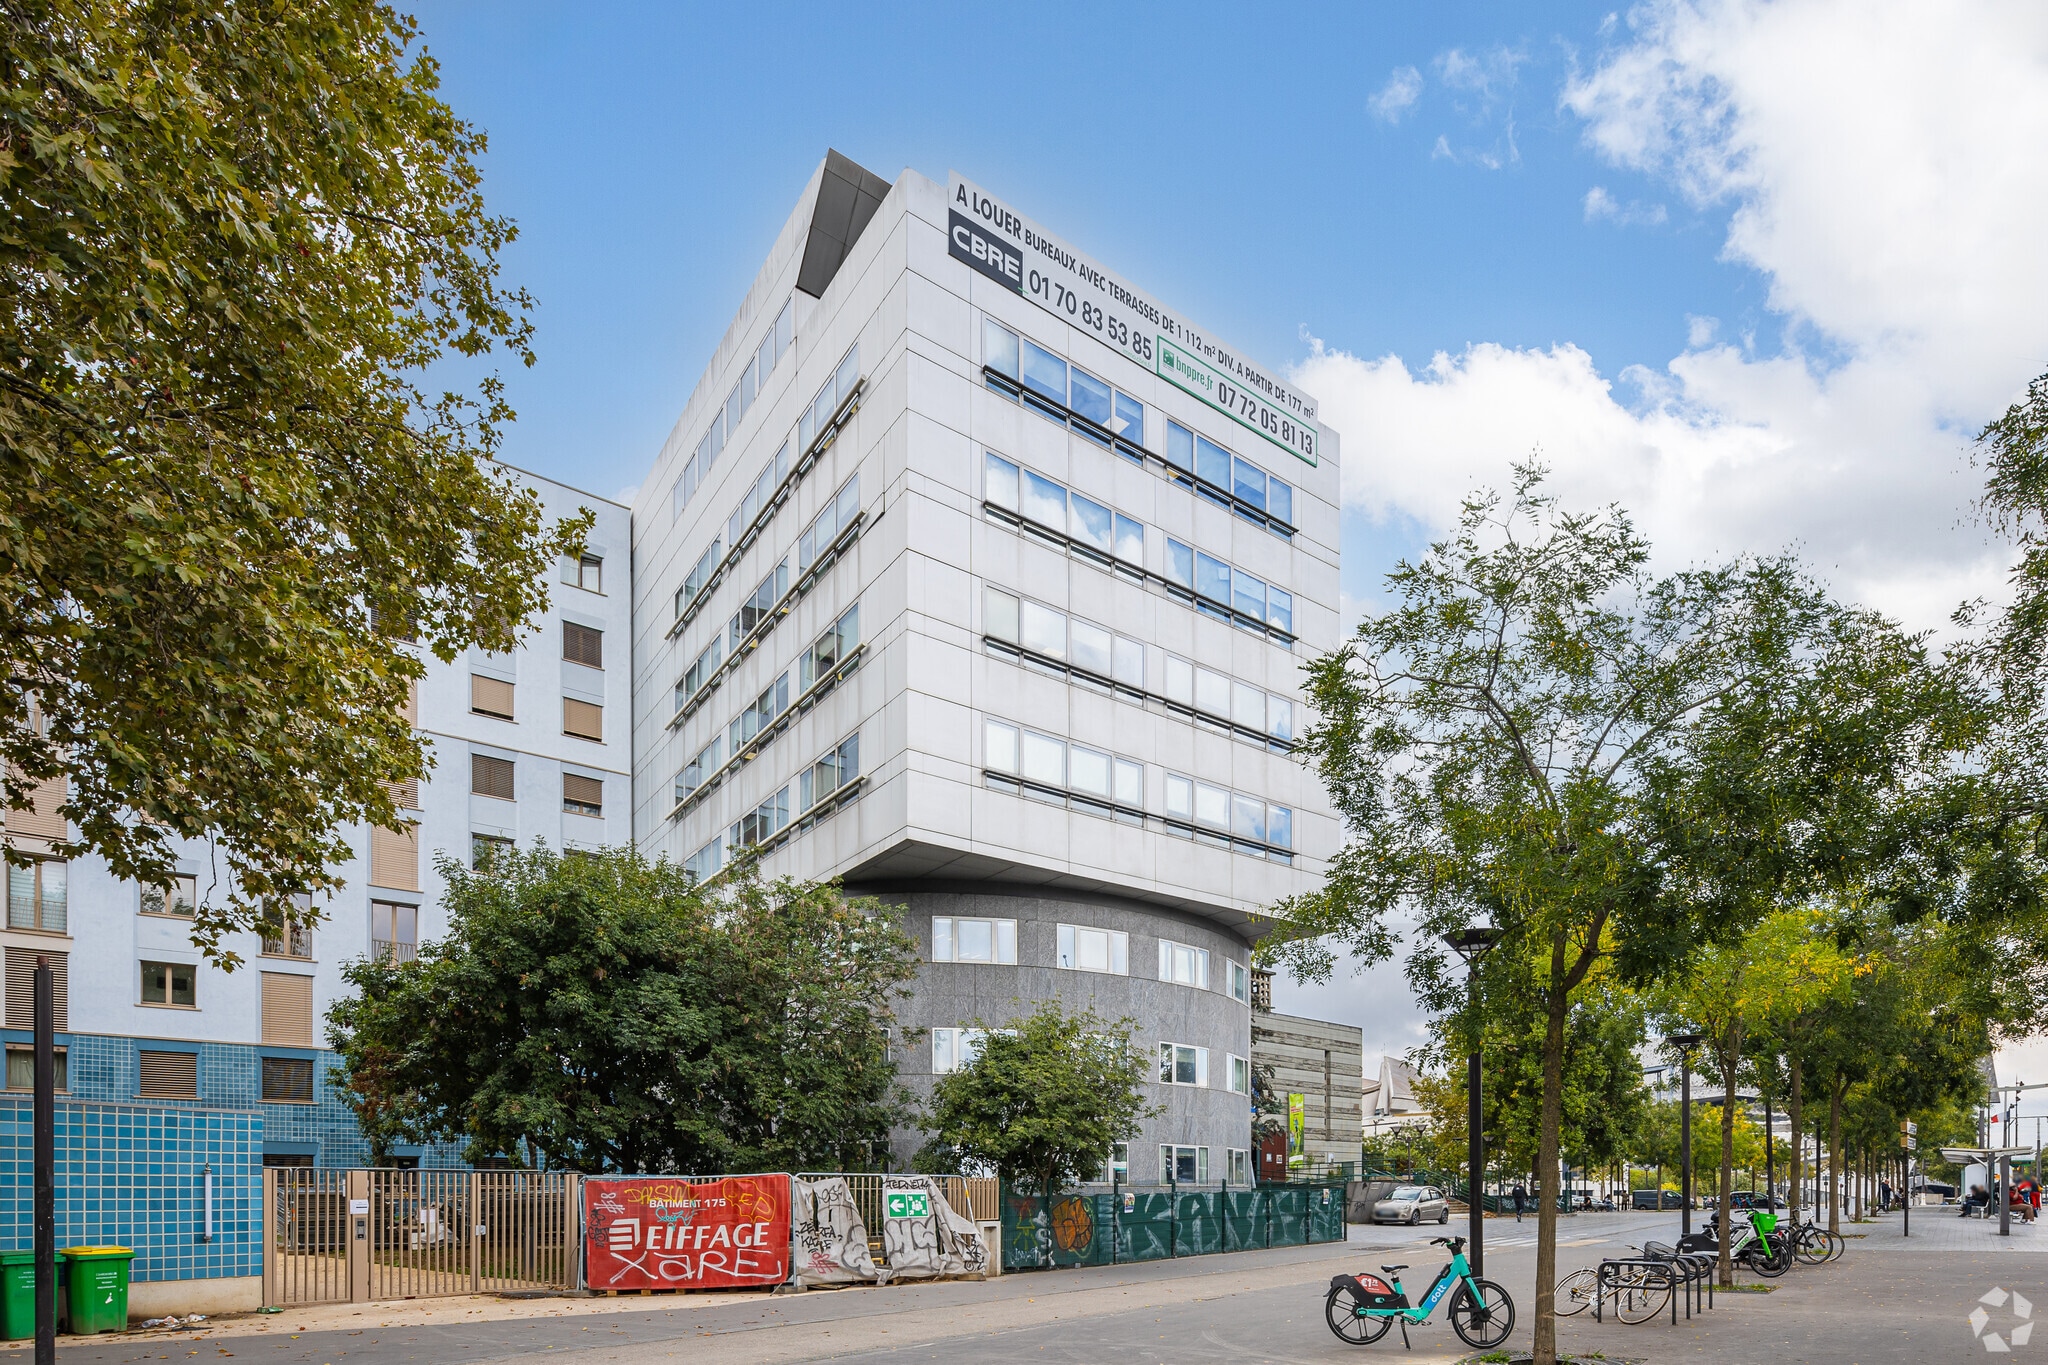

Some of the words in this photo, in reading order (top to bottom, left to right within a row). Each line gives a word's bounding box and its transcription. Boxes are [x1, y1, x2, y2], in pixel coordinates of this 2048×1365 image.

[952, 225, 1020, 282] CBRE
[956, 183, 968, 207] A
[973, 191, 1022, 240] LOUER
[1025, 228, 1077, 274] BUREAUX
[1079, 263, 1106, 292] AVEC
[1108, 280, 1159, 325] TERRASSES
[1162, 314, 1174, 334] DE
[1177, 324, 1181, 338] 1
[1186, 329, 1201, 351] 112
[1218, 349, 1235, 371] DIV.
[1236, 362, 1244, 377] A
[1245, 366, 1273, 395] PARTIR
[1275, 385, 1285, 403] DE
[1288, 393, 1302, 412] 177
[1029, 269, 1049, 300] 01
[1054, 282, 1077, 315] 70
[1082, 300, 1103, 331] 83
[1108, 315, 1128, 346] 53
[1132, 331, 1152, 361] 85
[1176, 355, 1214, 391] bnppre.fr
[1218, 382, 1236, 409] 07
[1239, 394, 1257, 423] 72
[1260, 408, 1278, 435] 05
[1282, 420, 1295, 446] 81
[1299, 430, 1313, 455] 13
[704, 1198, 727, 1208] 175
[646, 1222, 770, 1250] EIFFAGE
[1431, 1284, 1447, 1303] dott
